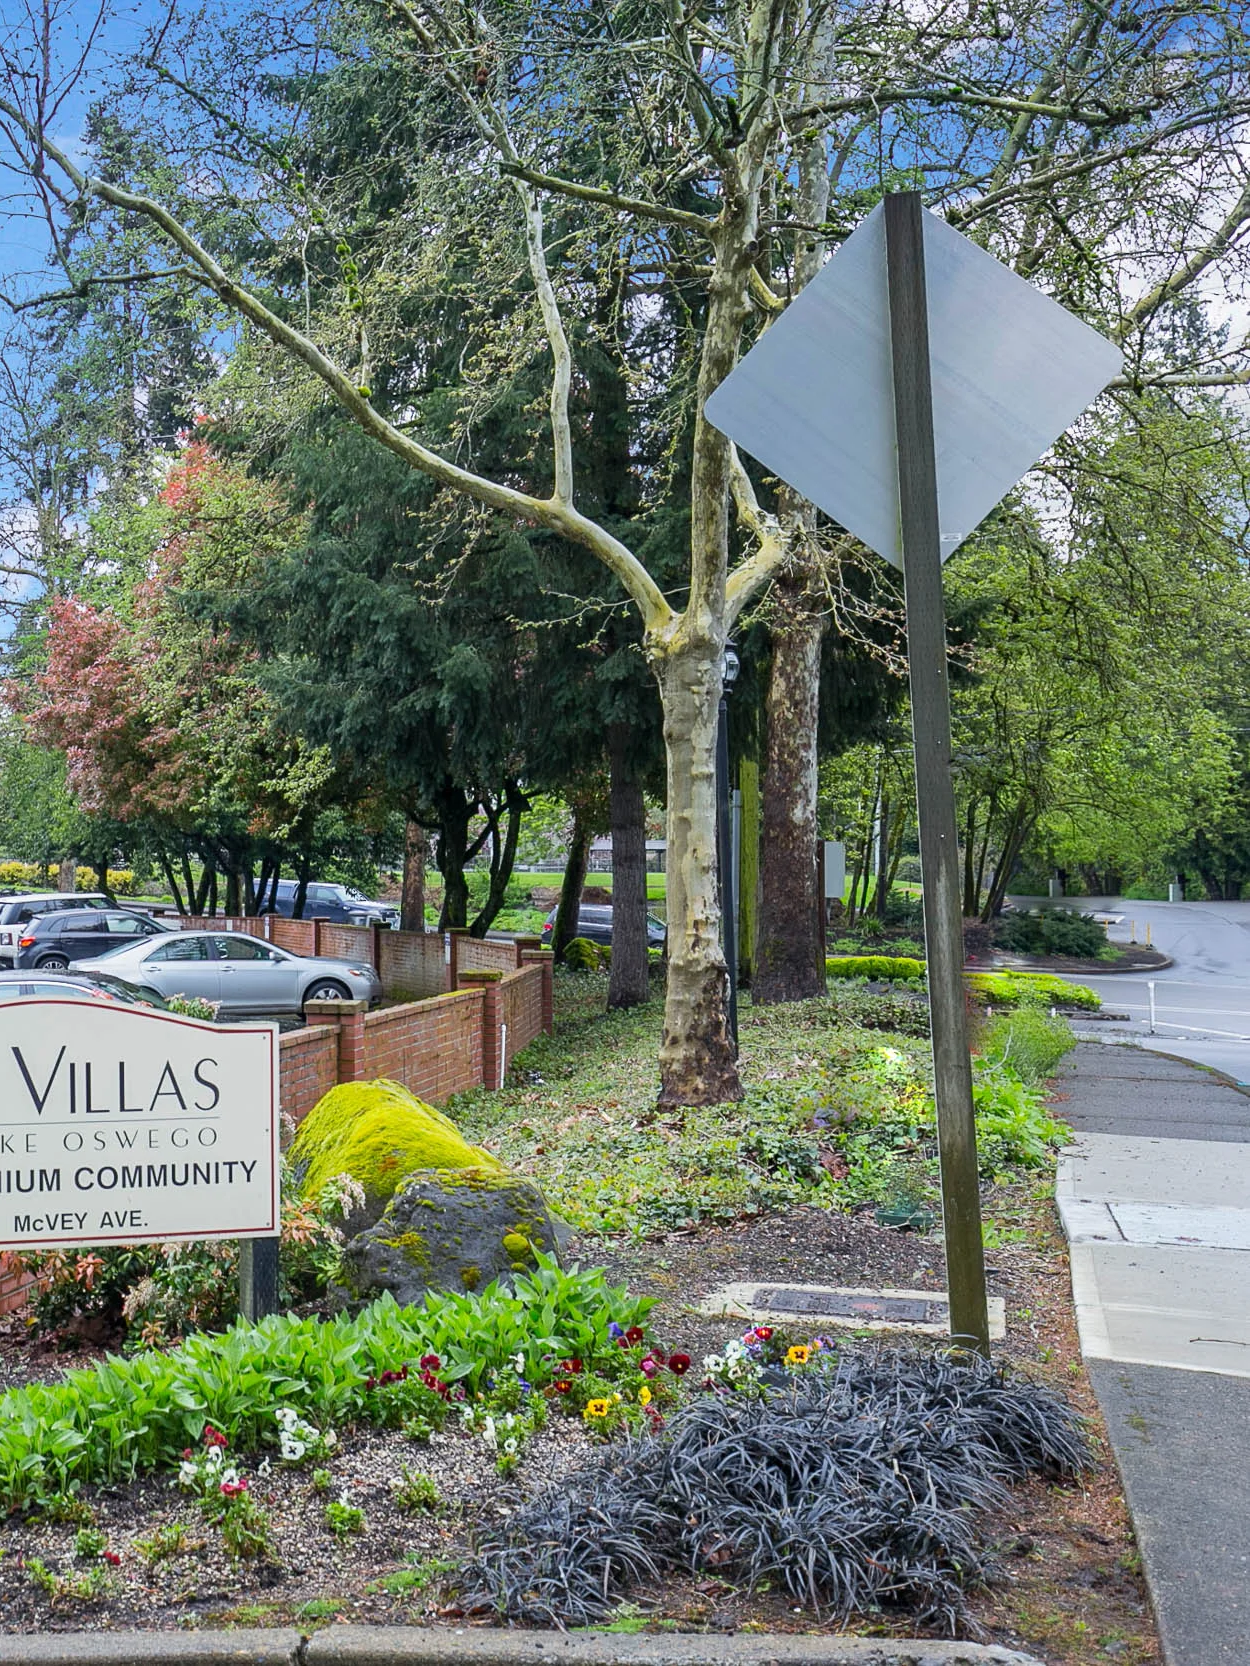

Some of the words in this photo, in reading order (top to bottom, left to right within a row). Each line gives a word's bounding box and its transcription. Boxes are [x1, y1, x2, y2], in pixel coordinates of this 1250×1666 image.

[12, 1045, 220, 1115] VILLAS
[63, 1126, 219, 1152] OSWEGO
[74, 1160, 257, 1191] COMMUNITY
[13, 1212, 88, 1233] McVEY
[99, 1210, 149, 1229] AVE.
